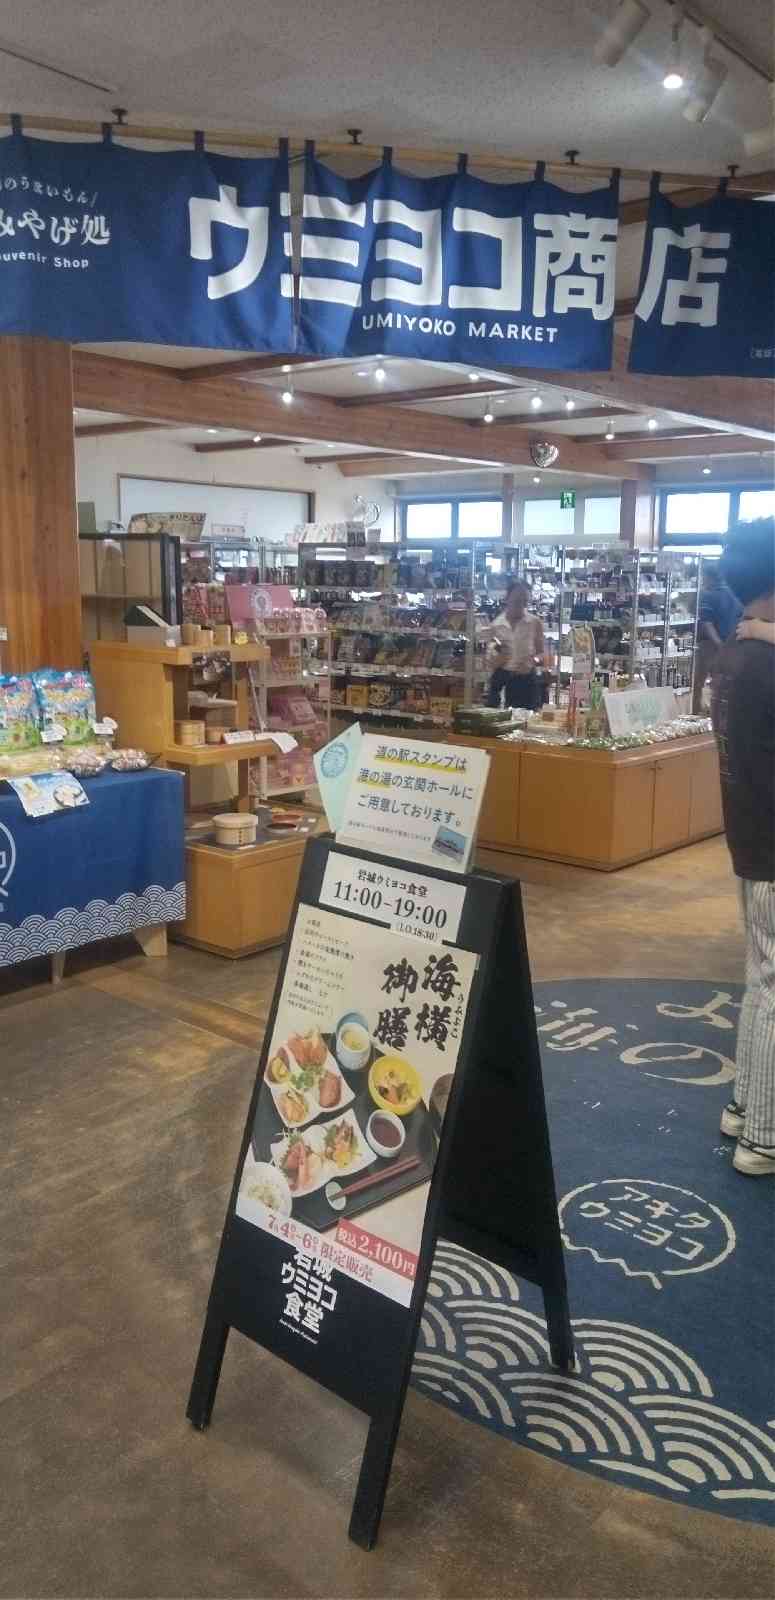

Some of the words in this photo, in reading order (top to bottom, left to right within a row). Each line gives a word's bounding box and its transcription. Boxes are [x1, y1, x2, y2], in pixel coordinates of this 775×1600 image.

[54, 256, 89, 270] Shop
[188, 184, 731, 327] ウミヨコ商店
[362, 312, 456, 336] UMIYOKO
[468, 323, 559, 343] MARKET
[374, 745, 468, 772] 道の駅スタンプは
[357, 793, 463, 828] ご用意しております。
[357, 869, 430, 898] 岩城ウミヨコ食堂
[609, 1185, 712, 1229] アキタ
[578, 1201, 705, 1262] ウミヨコ
[280, 1261, 338, 1312] ウミヨコ
[283, 1290, 325, 1334] 食堂
